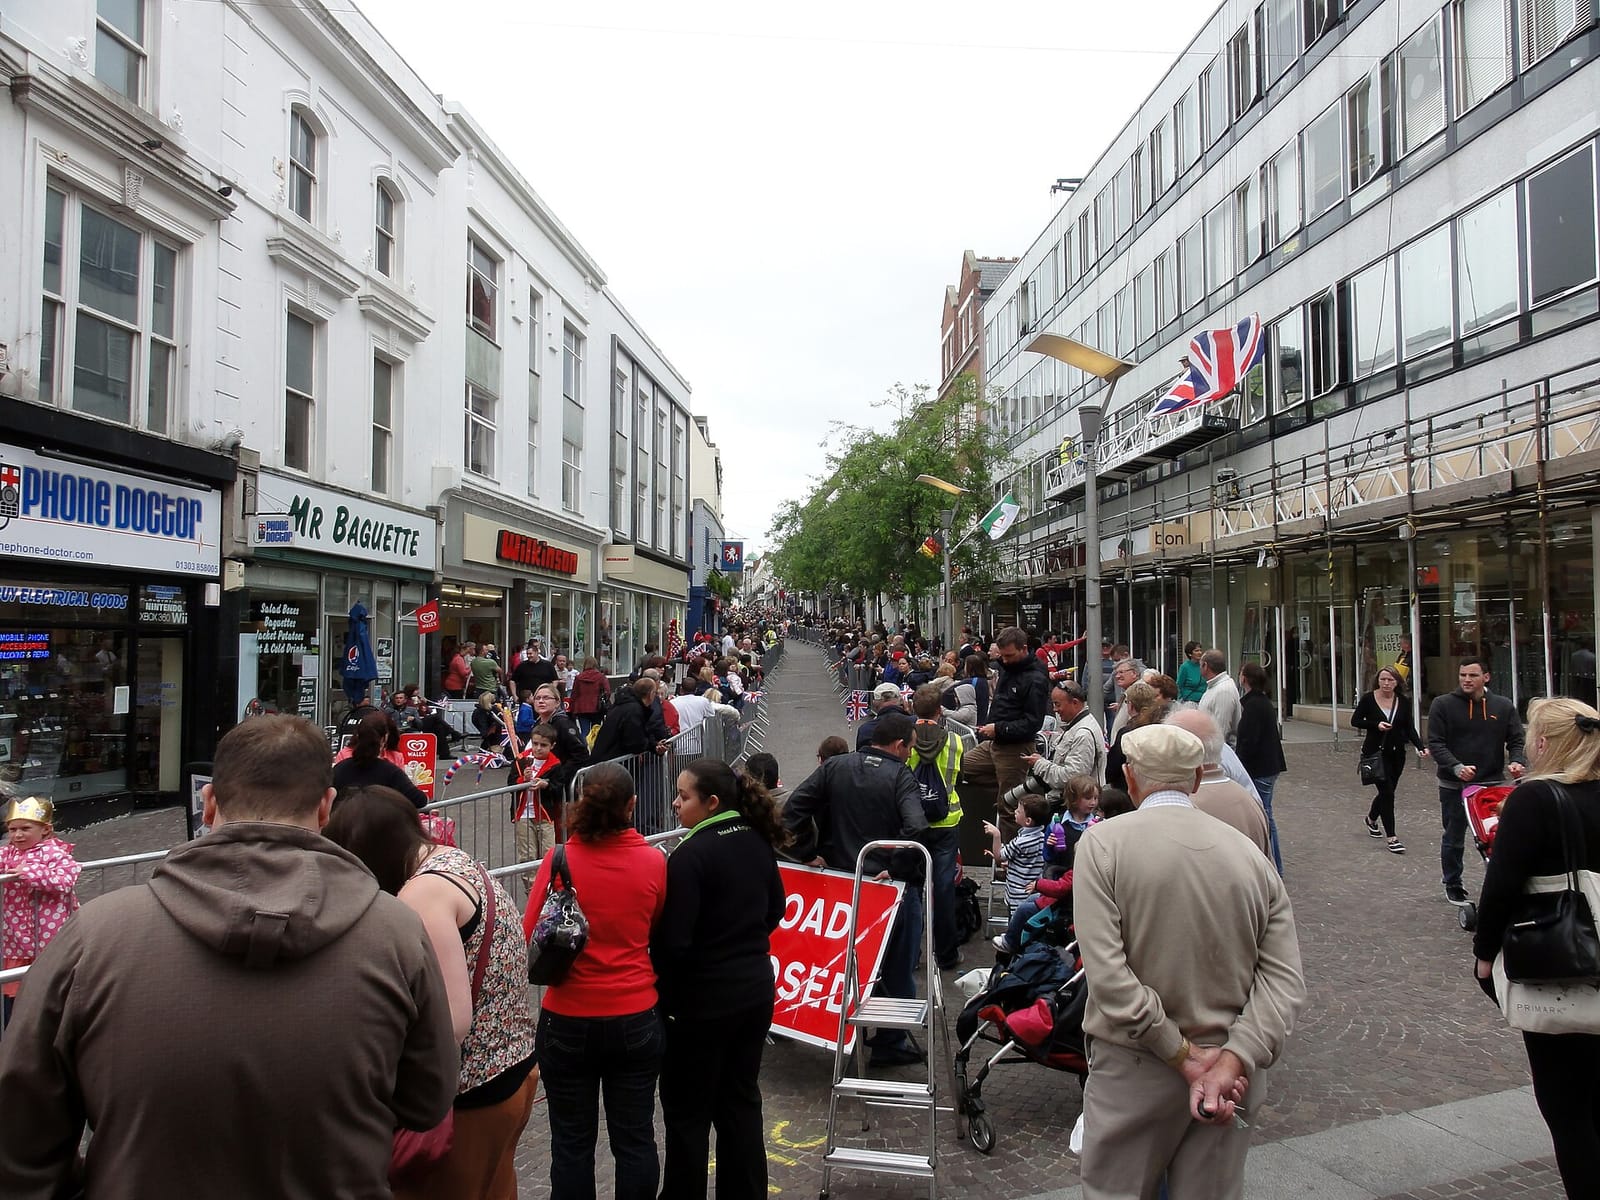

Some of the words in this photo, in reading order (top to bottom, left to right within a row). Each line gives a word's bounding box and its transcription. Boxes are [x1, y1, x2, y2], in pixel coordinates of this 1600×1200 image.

[288, 494, 324, 540] MR
[332, 505, 420, 557] BAGUETTE
[498, 530, 578, 575] Wilkinson
[175, 560, 196, 573] 01303
[196, 561, 218, 574] 858005
[0, 586, 19, 603] UY
[19, 587, 89, 608] ELECTRICAL
[91, 592, 129, 610] GOODS
[260, 602, 282, 614] Salad
[171, 612, 188, 625] Wii
[264, 616, 297, 630] Baguettes
[277, 630, 304, 641] Potatoes
[270, 643, 286, 653] Cold
[779, 893, 852, 939] OAD
[1516, 1003, 1564, 1015] PRIMARK
